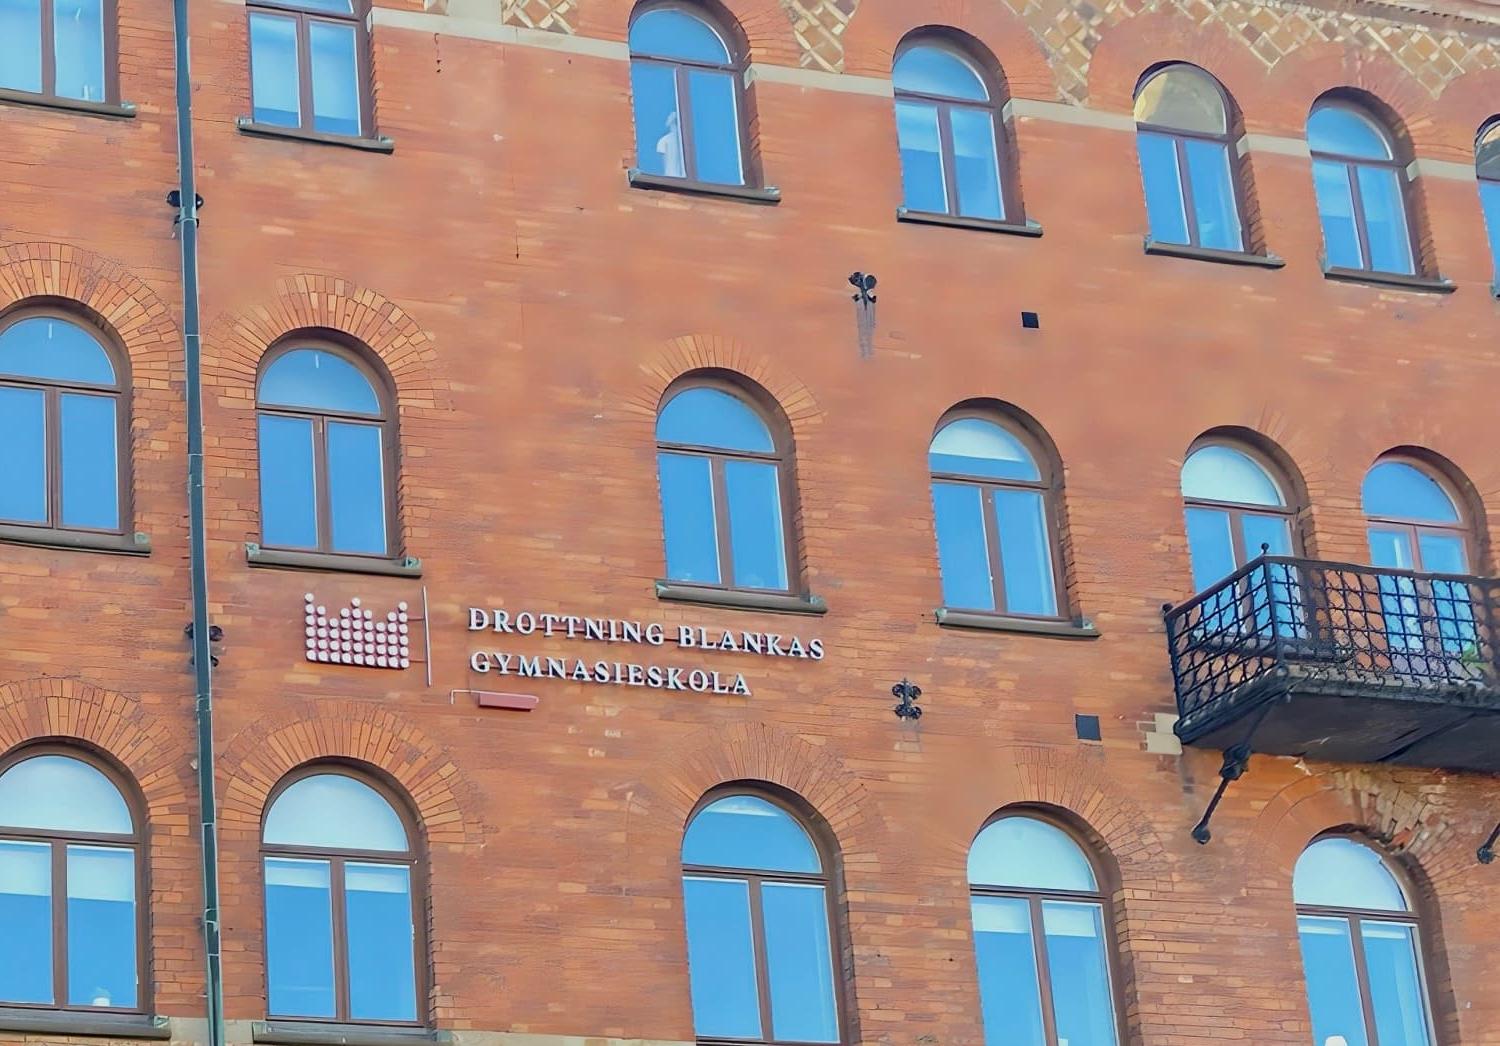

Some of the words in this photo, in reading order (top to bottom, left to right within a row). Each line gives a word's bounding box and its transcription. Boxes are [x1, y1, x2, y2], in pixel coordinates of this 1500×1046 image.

[467, 607, 665, 646] DROTTNING
[677, 624, 825, 660] BLANKAS
[469, 650, 752, 696] GYMNASIESKOLA
